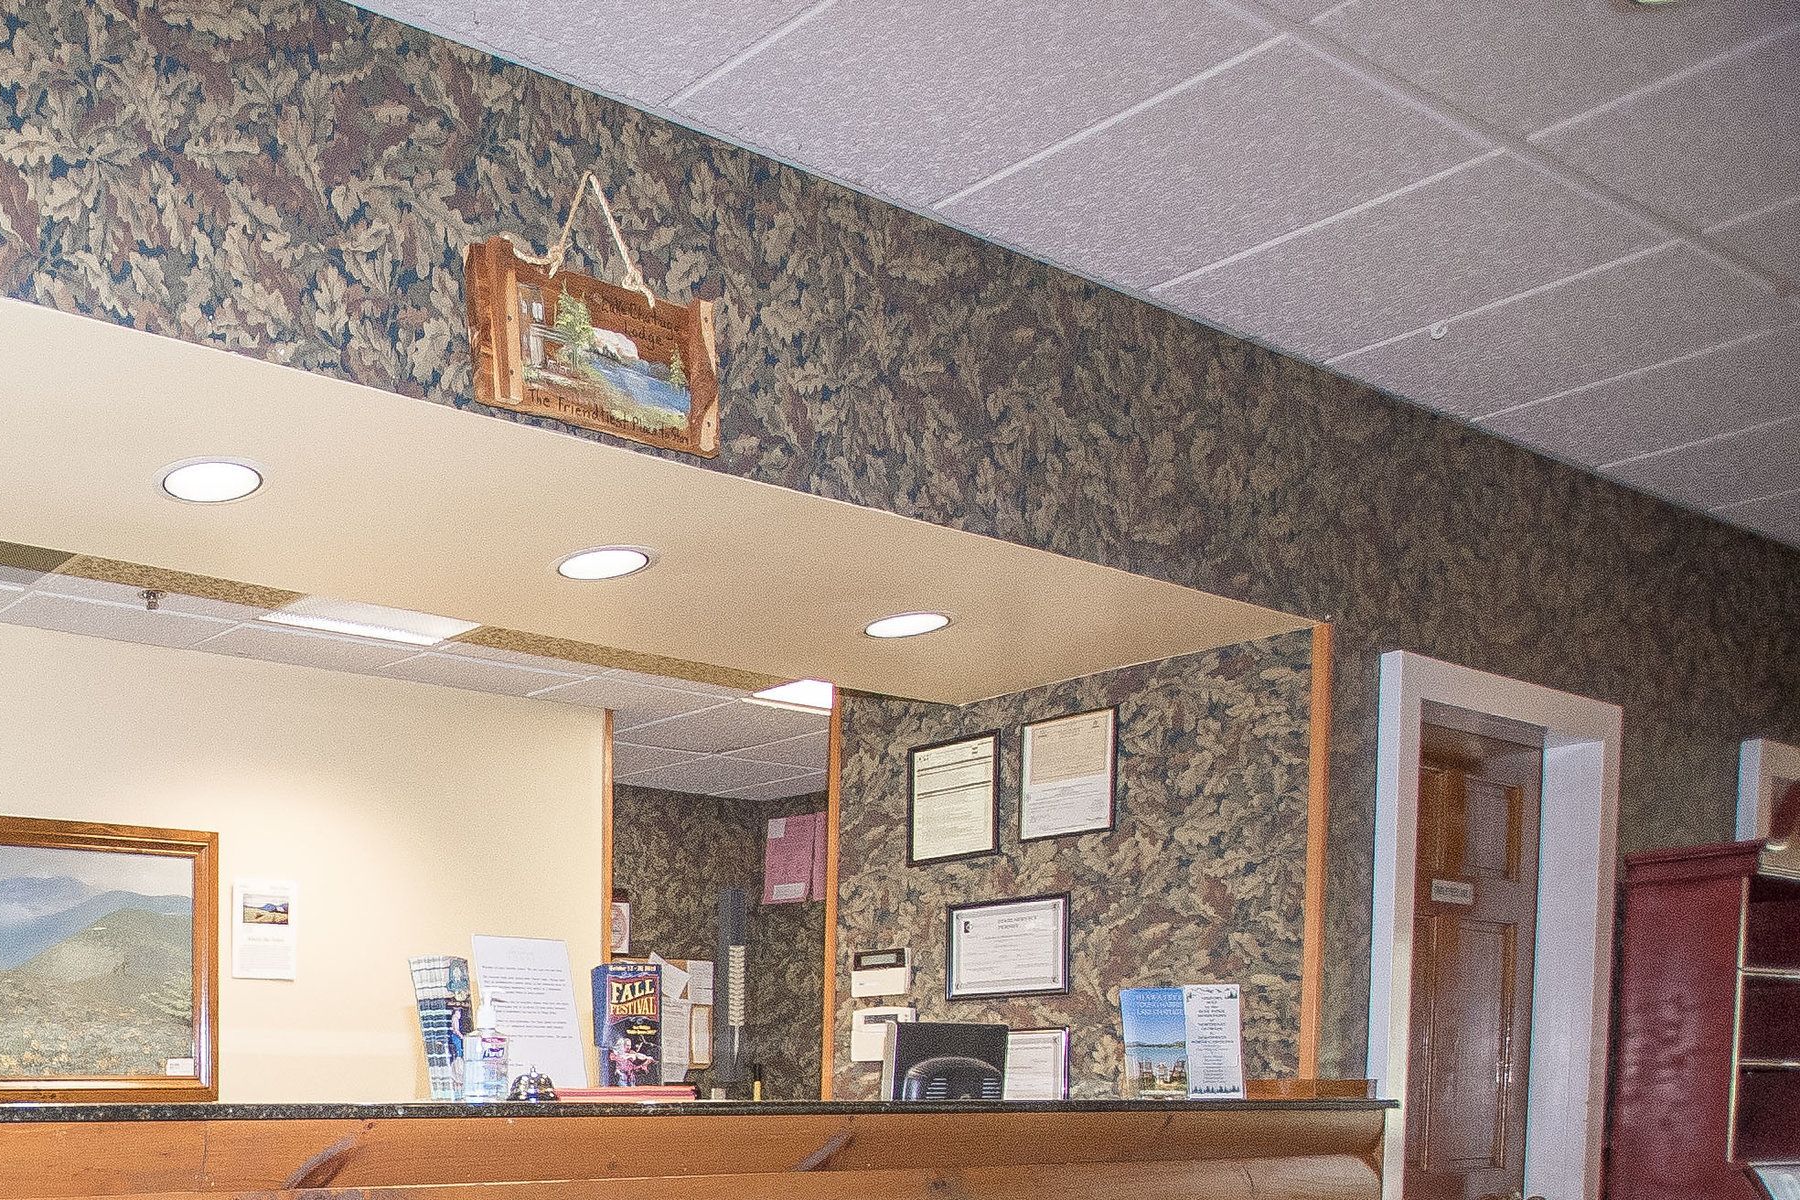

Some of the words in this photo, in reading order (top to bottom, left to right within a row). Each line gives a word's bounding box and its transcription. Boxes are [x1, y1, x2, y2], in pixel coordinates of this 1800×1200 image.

[623, 320, 663, 350] Lodge
[527, 388, 551, 408] The
[610, 979, 655, 1004] FALL
[609, 996, 657, 1015] FESTIVAL
